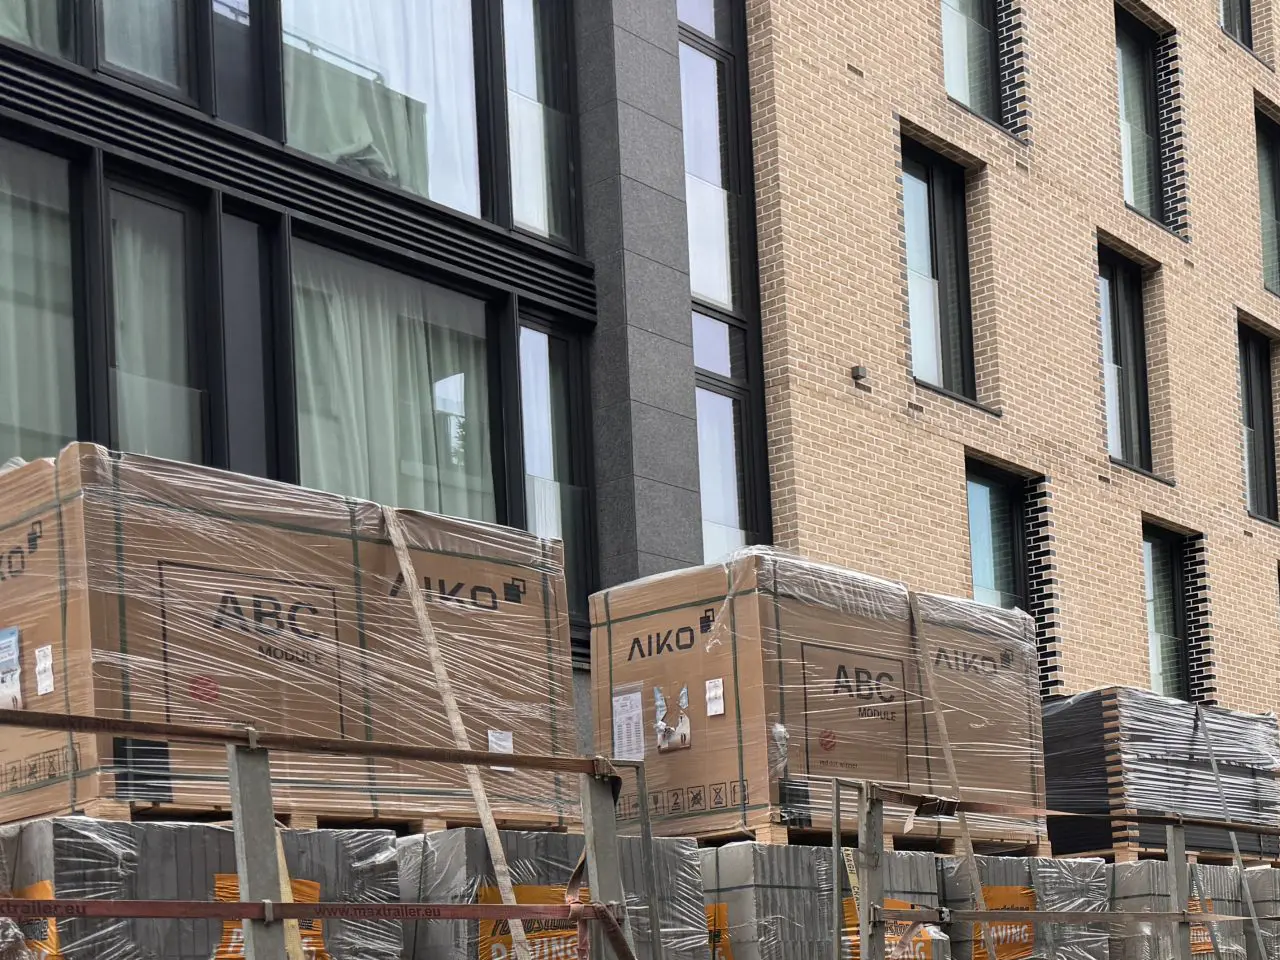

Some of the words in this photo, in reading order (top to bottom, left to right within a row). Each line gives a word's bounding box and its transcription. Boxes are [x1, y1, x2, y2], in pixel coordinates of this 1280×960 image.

[213, 590, 320, 640] ABC
[258, 645, 323, 665] MODULE
[627, 626, 695, 661] AIKO
[935, 647, 998, 675] AIKO
[833, 664, 896, 703] ABC
[858, 707, 897, 722] MODULE
[313, 904, 442, 918] www.maxtrailer.eu
